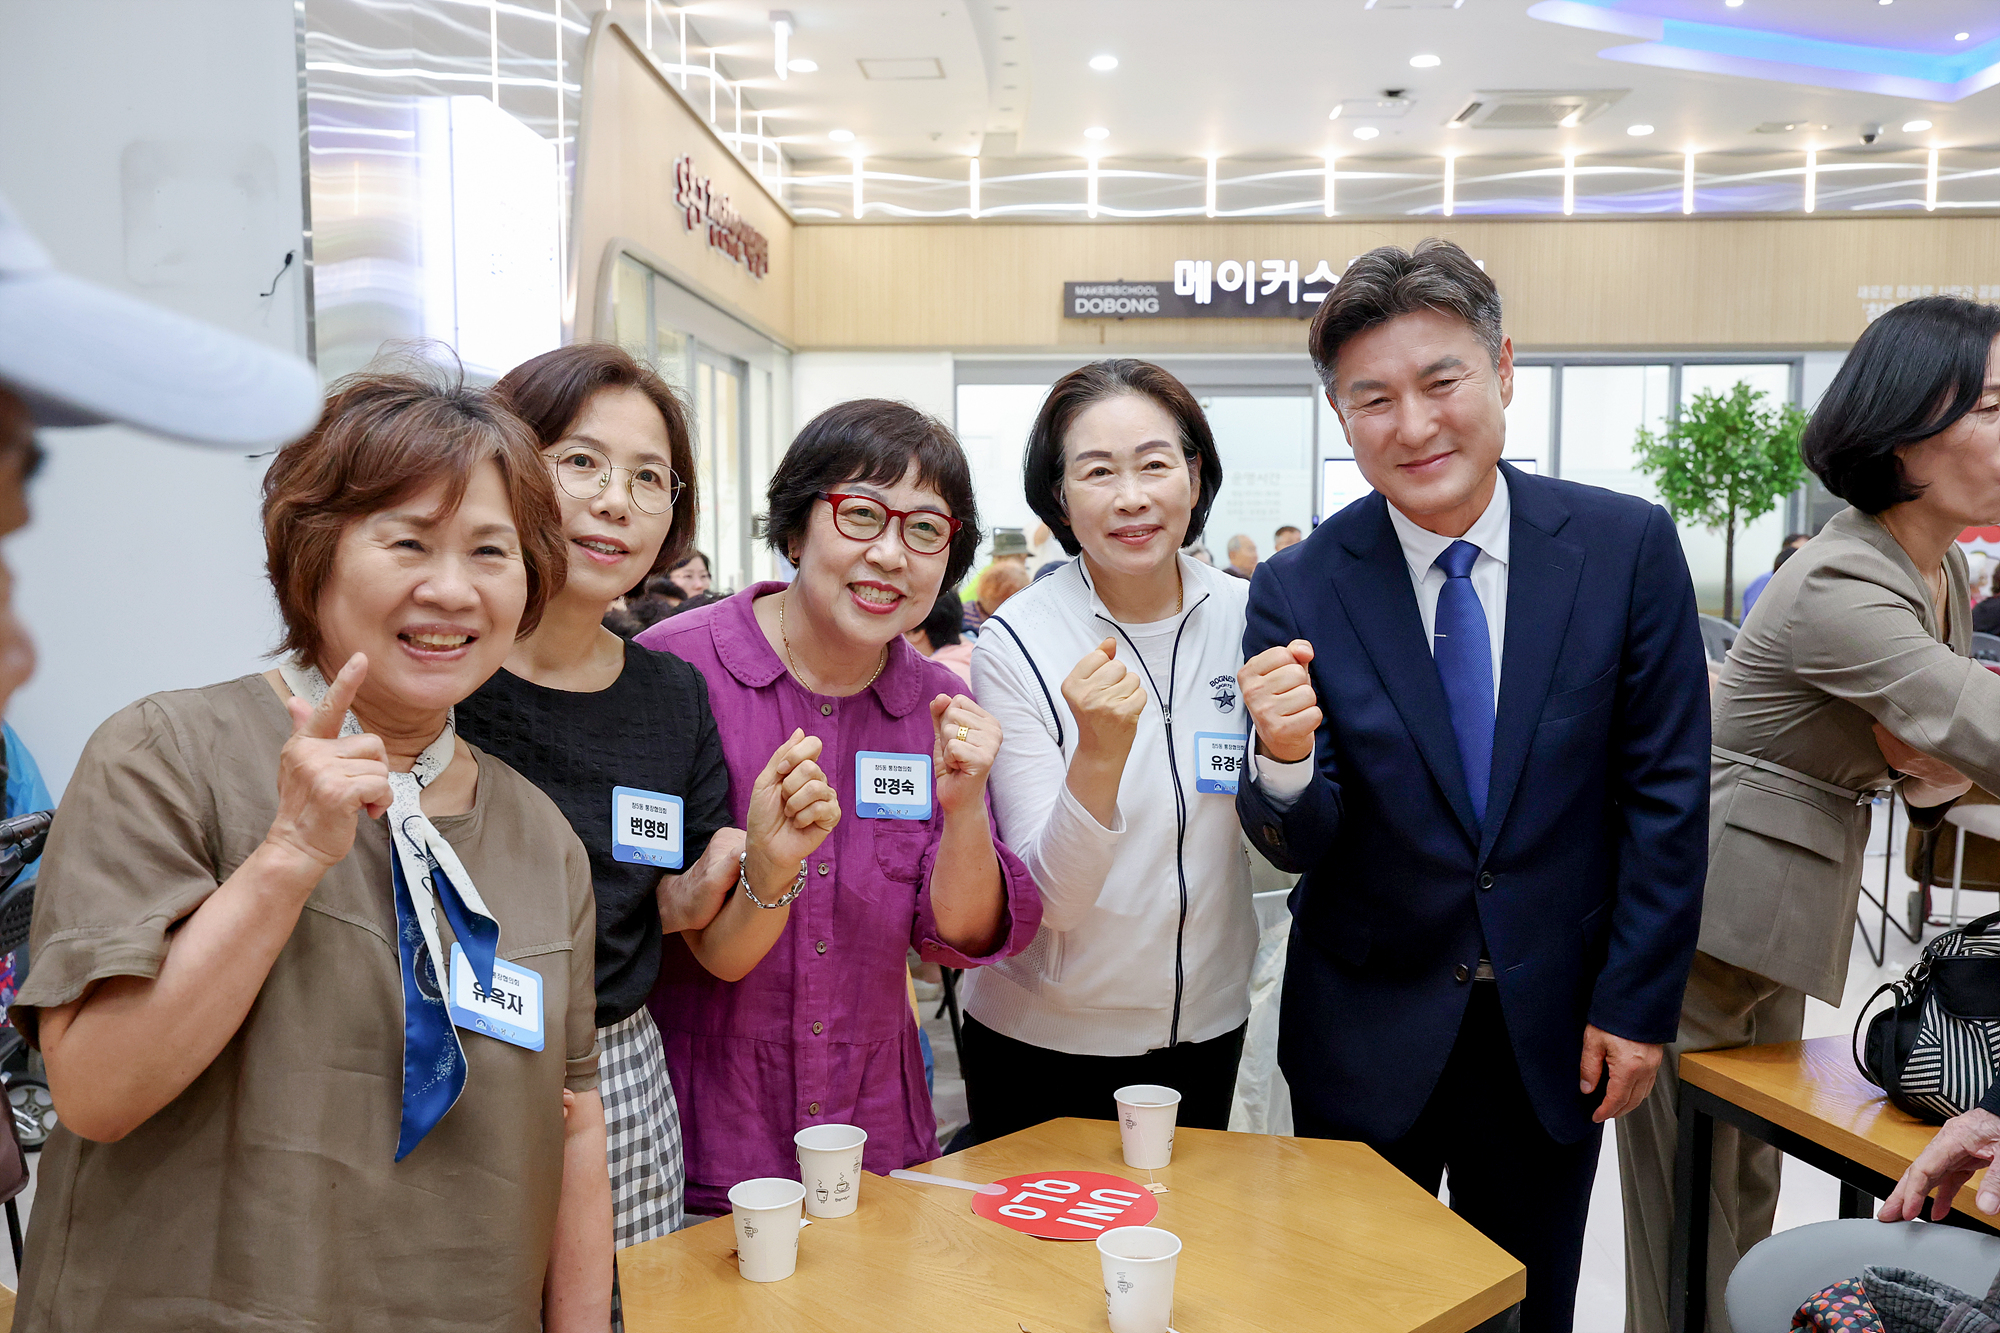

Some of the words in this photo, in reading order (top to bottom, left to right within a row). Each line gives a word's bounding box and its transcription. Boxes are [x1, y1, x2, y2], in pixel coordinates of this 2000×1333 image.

[1074, 285, 1159, 296] MAKERSCHOOL
[1074, 297, 1160, 314] DOBONG
[873, 777, 915, 796] 안경숙
[630, 816, 669, 841] 변영희
[472, 981, 524, 1016] 유옥자
[998, 1179, 1081, 1220] QLO
[1055, 1188, 1142, 1230] UNI
